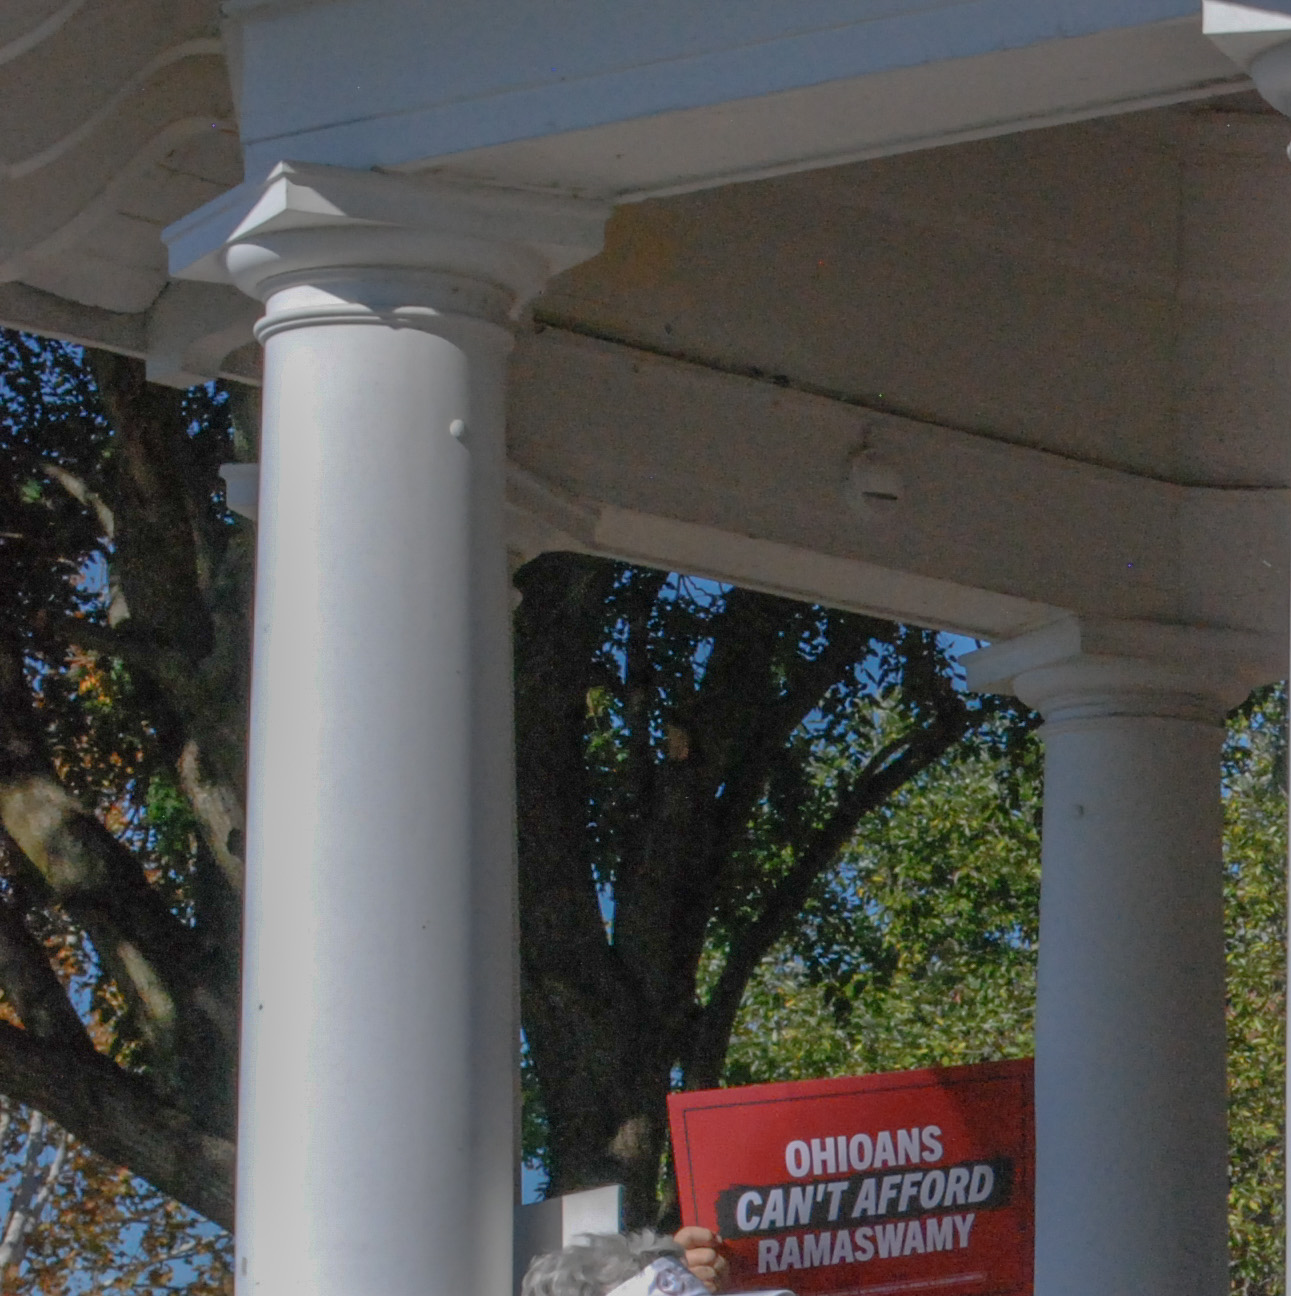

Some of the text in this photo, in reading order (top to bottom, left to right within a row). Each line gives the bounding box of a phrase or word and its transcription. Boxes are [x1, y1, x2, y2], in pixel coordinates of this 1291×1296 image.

[785, 1125, 944, 1178] OHIOANS
[736, 1164, 994, 1231] CAN'T AFFORD
[757, 1213, 975, 1274] RAMASWAMY
